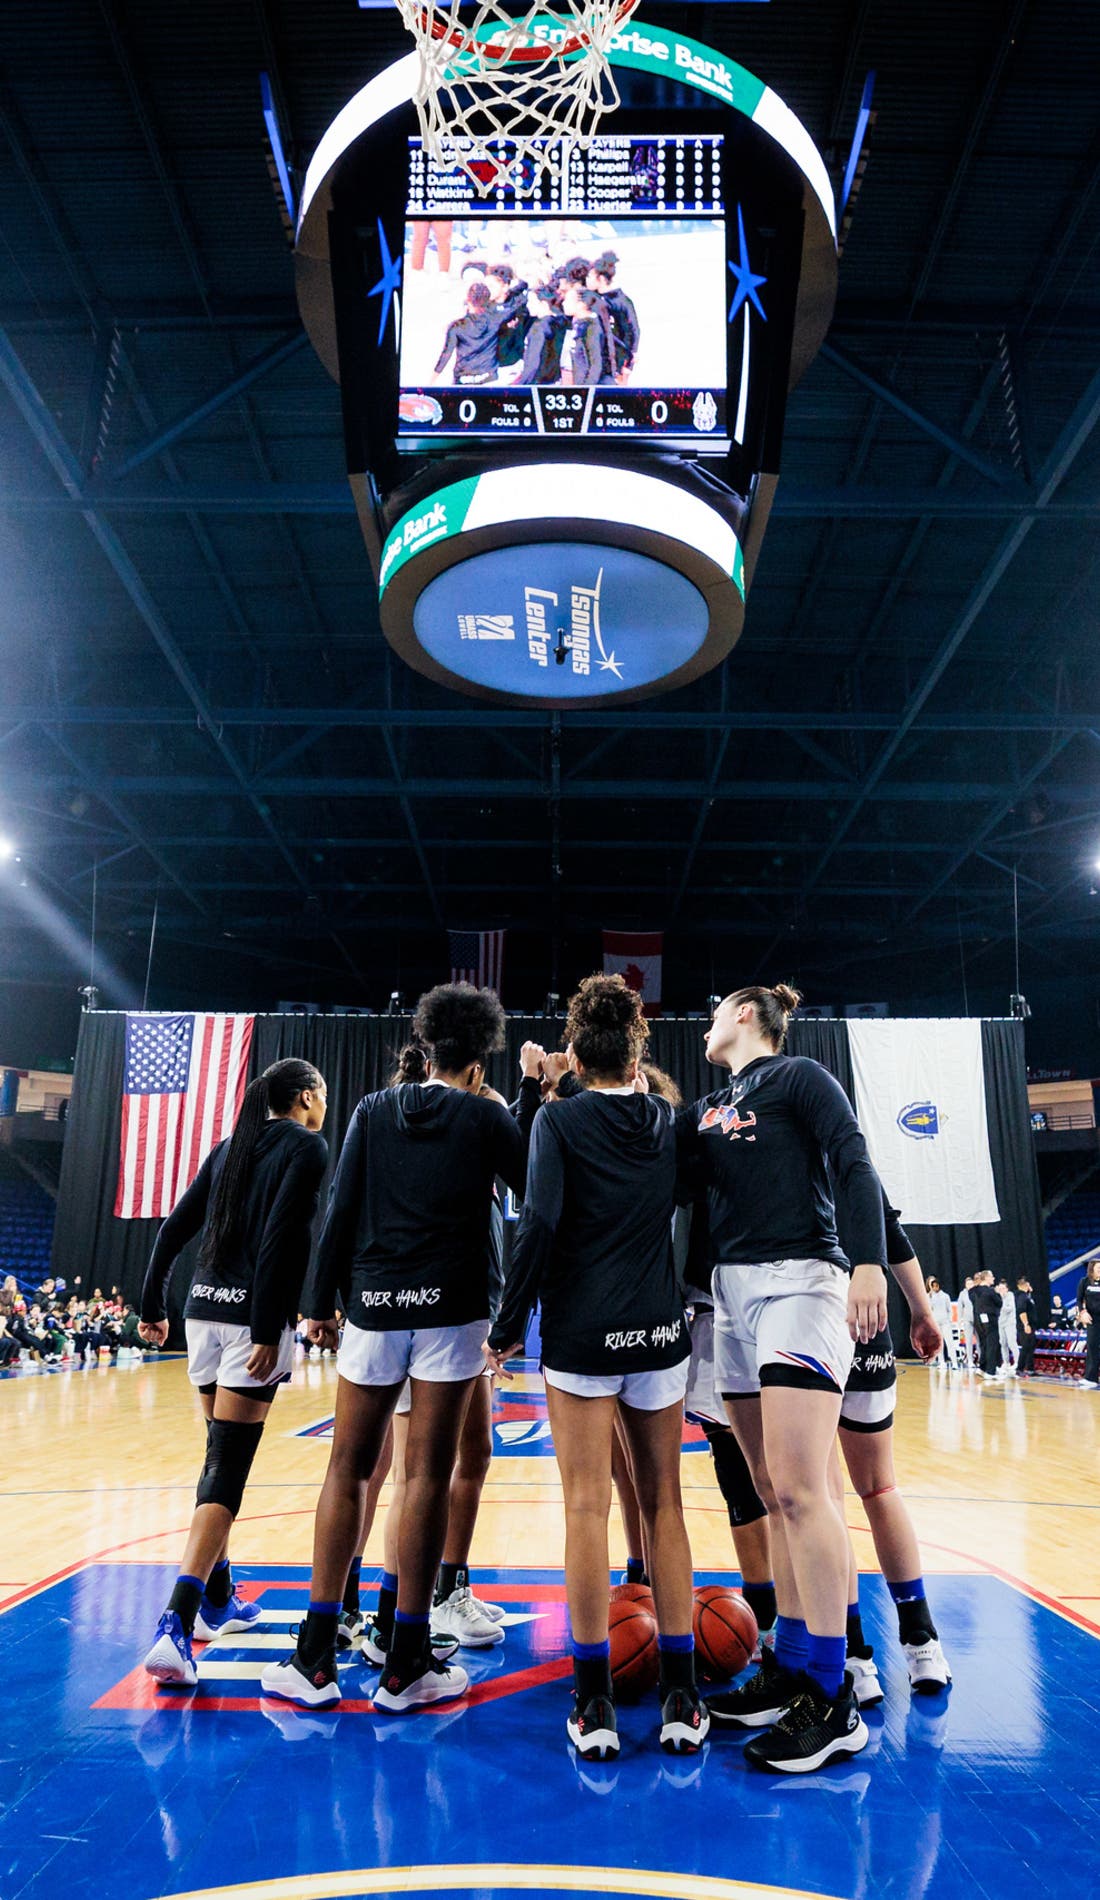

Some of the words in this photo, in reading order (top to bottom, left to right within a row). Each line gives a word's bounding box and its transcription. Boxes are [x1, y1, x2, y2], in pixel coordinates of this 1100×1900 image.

[675, 44, 733, 90] Bank
[409, 150, 423, 161] 11
[571, 149, 581, 160] 3
[588, 149, 629, 160] Phillips
[410, 162, 425, 173] 12
[570, 162, 585, 173] 13
[409, 174, 424, 186] 14
[427, 174, 466, 186] Durant
[570, 174, 584, 185] 14
[426, 187, 474, 199] Watkins
[587, 187, 631, 199] Cooper
[503, 403, 519, 413] TOL
[523, 403, 531, 413] 4
[545, 394, 582, 410] 33.3
[596, 403, 604, 413] 4
[607, 404, 623, 413] TOL
[458, 400, 476, 422] 0
[651, 400, 668, 423] 0
[491, 417, 519, 427] FOULS
[553, 418, 574, 428] 1ST
[606, 417, 635, 427] FOULS
[403, 502, 447, 547] Bank
[524, 586, 558, 667] Center
[563, 568, 603, 676] Tsongas
[213, 1286, 247, 1304] HAWKS
[361, 1290, 392, 1308] RIVER
[396, 1286, 441, 1309] HAWKS
[605, 1329, 647, 1351] RIVER
